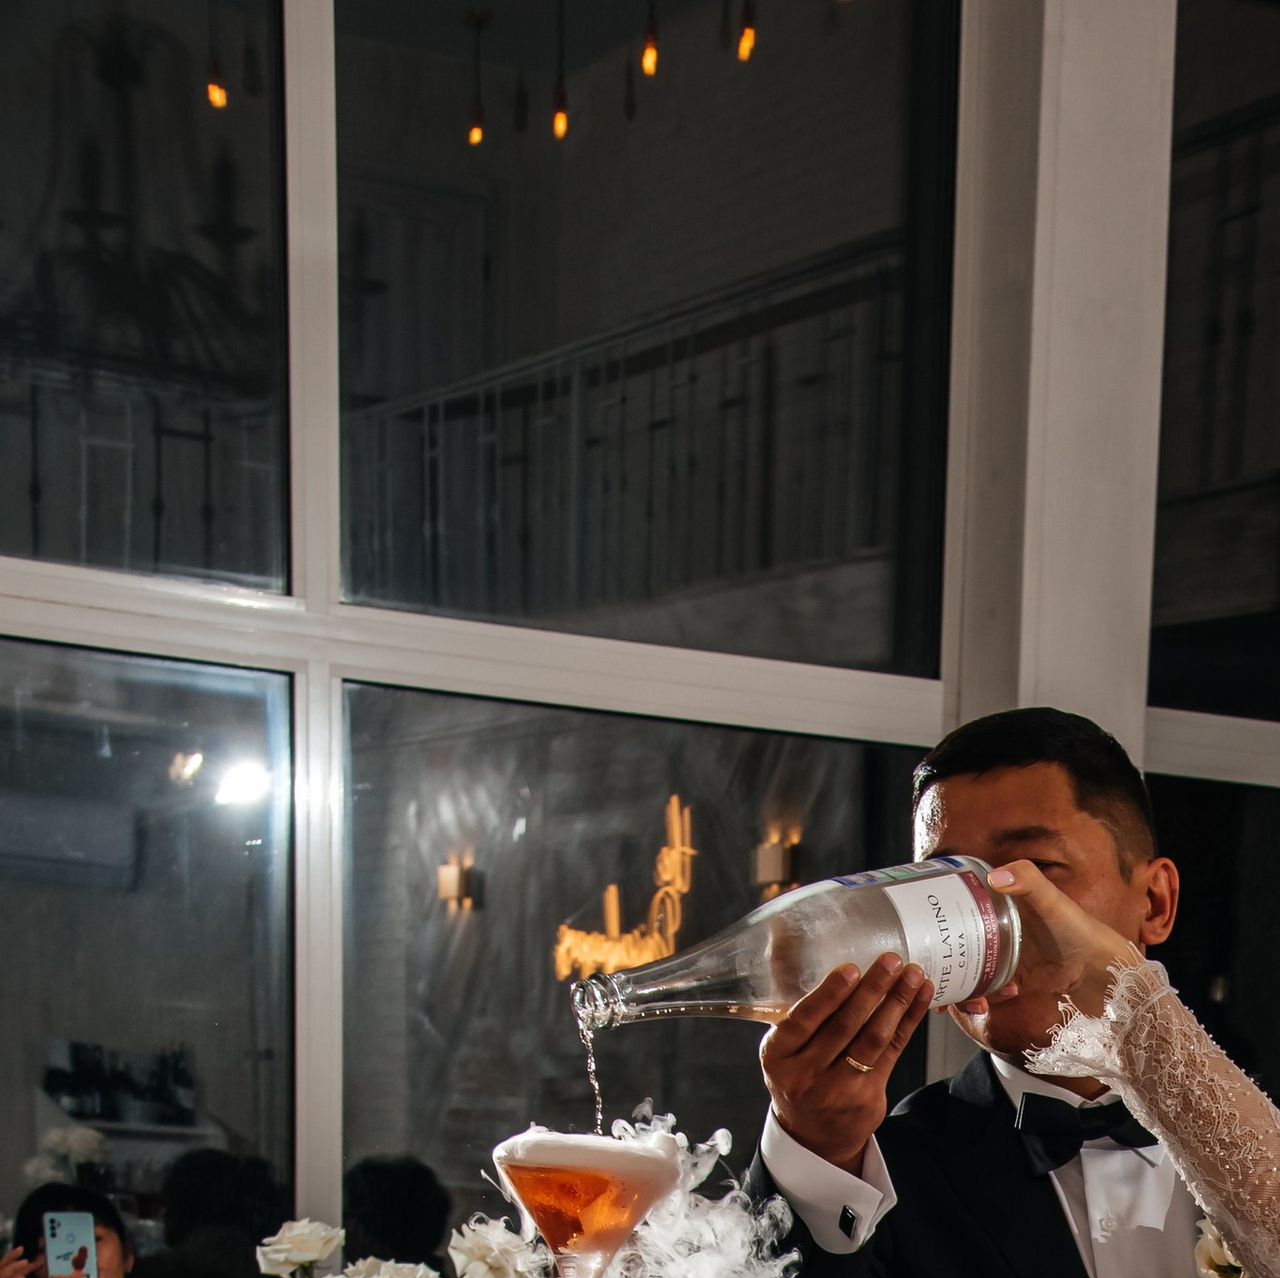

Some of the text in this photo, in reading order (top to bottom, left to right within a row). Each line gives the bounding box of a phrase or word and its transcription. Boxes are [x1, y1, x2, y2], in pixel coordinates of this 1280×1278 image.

[927, 895, 953, 1001] ARTE LATINO
[958, 933, 966, 968] CAVA
[984, 949, 993, 973] BRUT
[985, 903, 998, 978] TRADITIONAL METHOD
